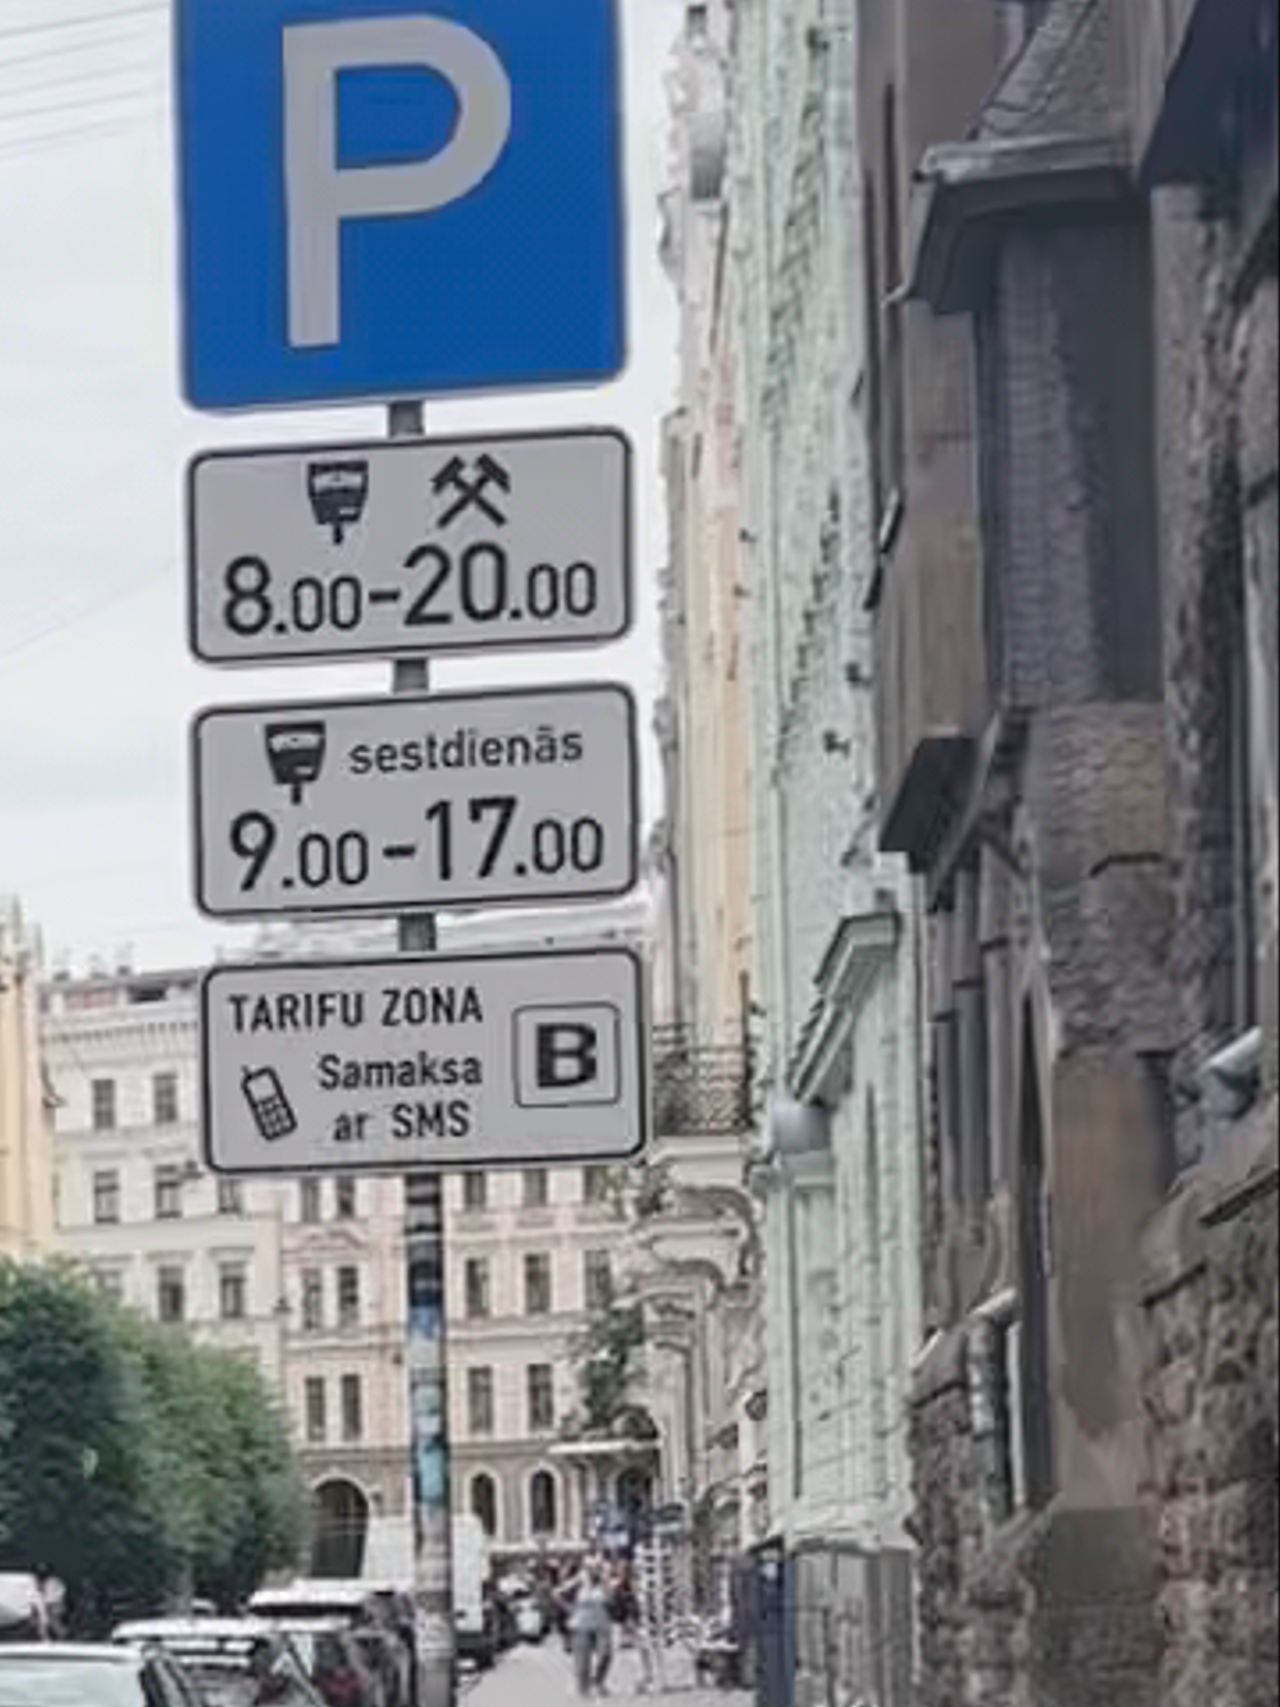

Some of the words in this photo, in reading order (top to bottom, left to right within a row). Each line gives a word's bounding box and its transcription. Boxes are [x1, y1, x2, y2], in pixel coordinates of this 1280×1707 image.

[283, 13, 512, 347] P
[224, 542, 597, 635] 8.00-20.00
[348, 726, 584, 774] sestdienās
[229, 992, 364, 1032] TARIFU
[381, 986, 483, 1027] ZONA
[317, 1051, 483, 1090] Samaksa
[536, 1022, 598, 1089] B
[333, 1114, 369, 1141] ar
[391, 1101, 470, 1139] SMS
